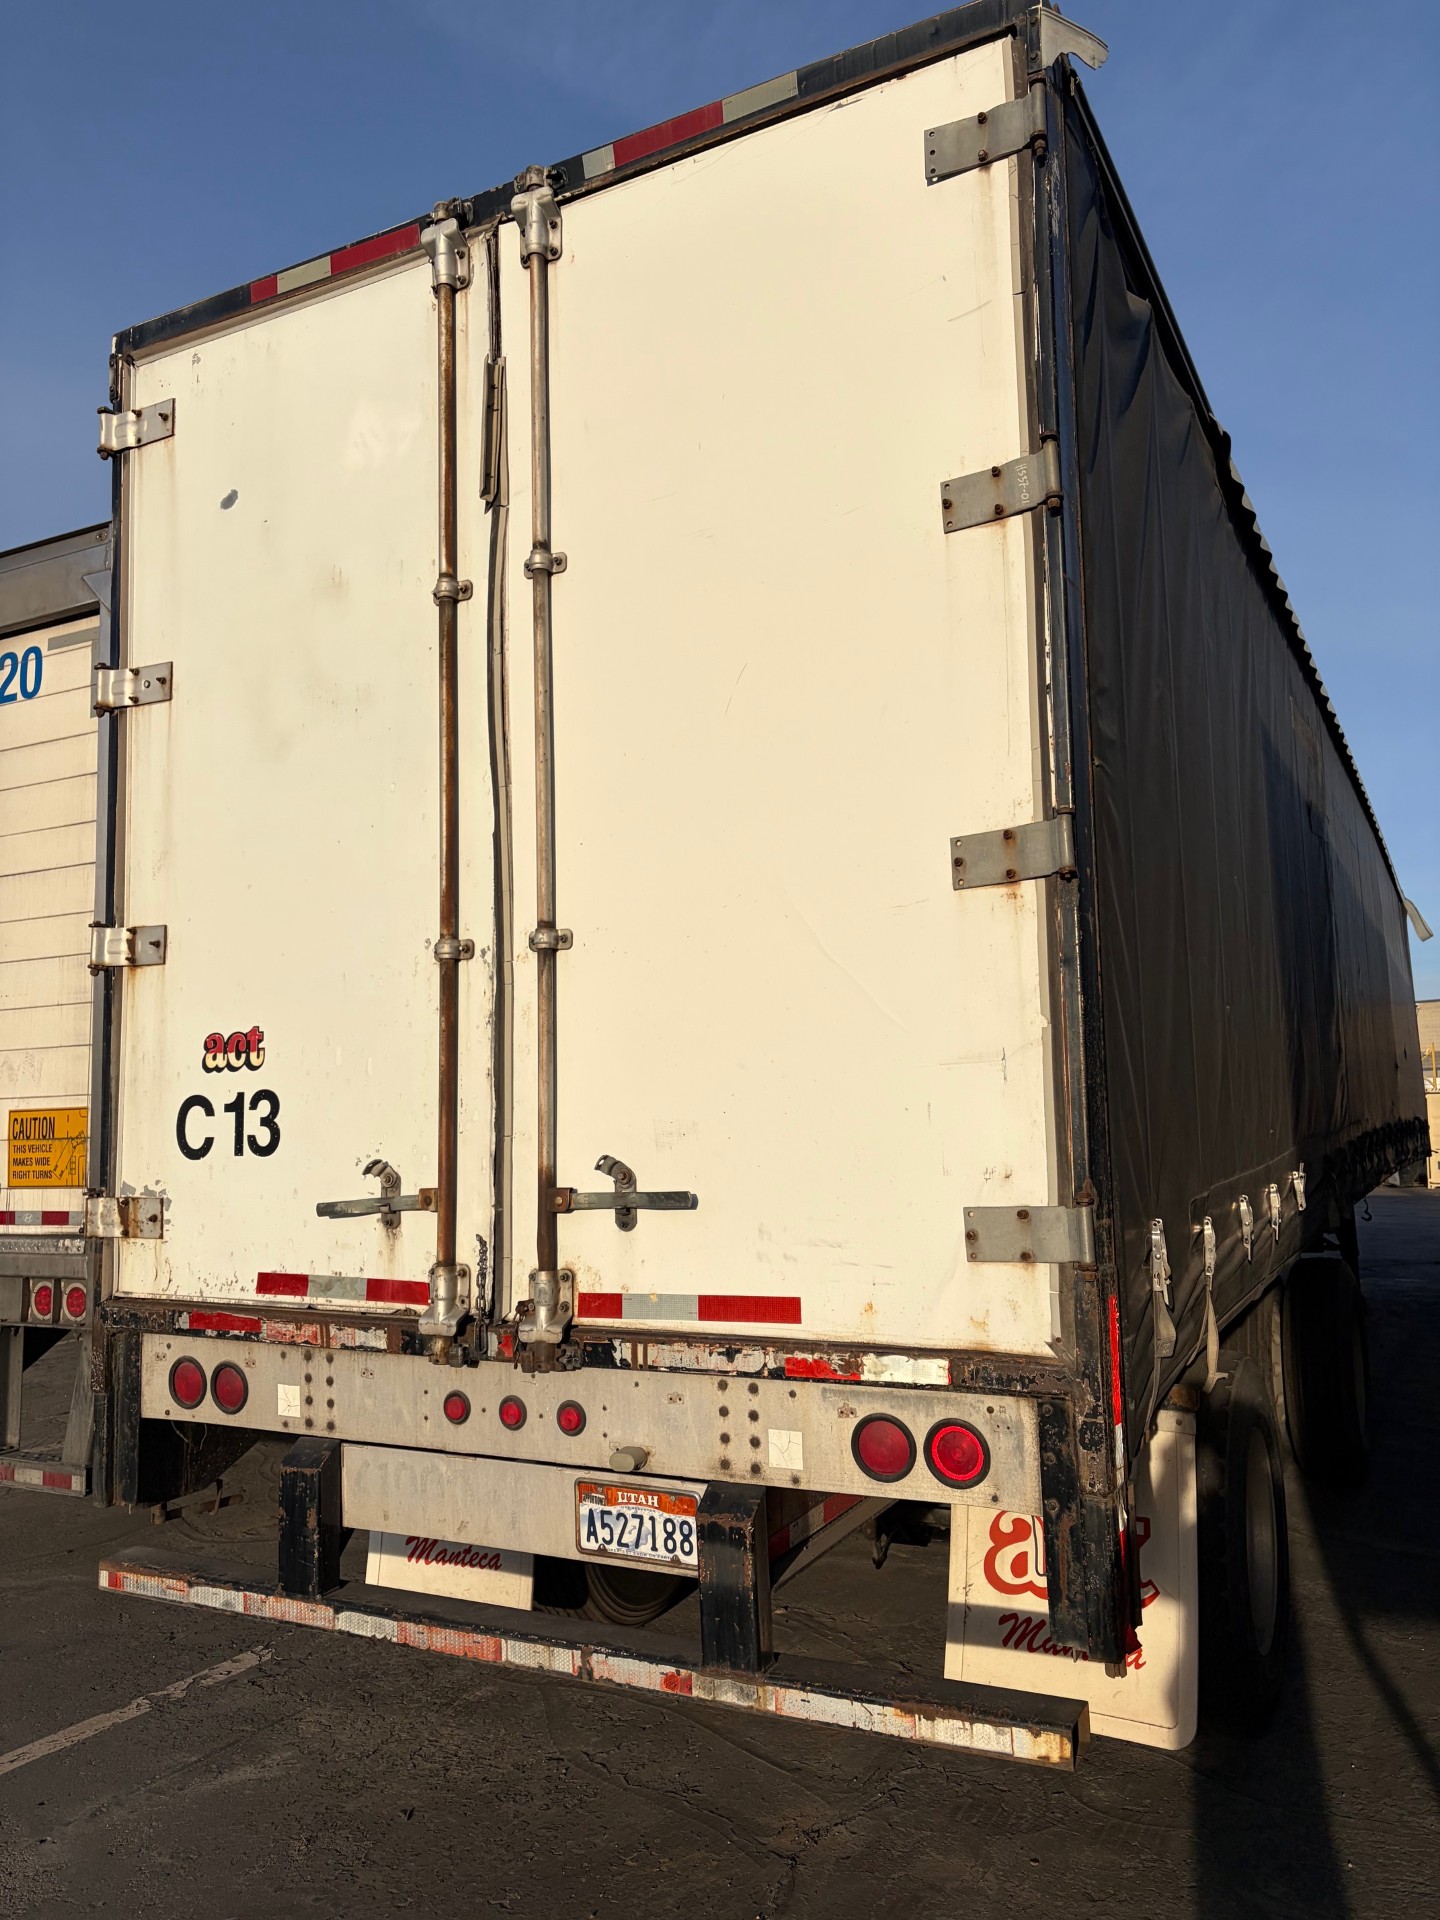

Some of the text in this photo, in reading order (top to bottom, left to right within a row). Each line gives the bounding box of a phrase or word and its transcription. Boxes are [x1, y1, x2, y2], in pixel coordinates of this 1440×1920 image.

[0, 645, 43, 705] 20
[202, 1026, 265, 1073] act
[12, 1116, 55, 1140] CAUTION
[13, 1144, 53, 1154] THIS VEHICLE
[12, 1157, 50, 1167] MAKES WIDE
[12, 1170, 53, 1180] RIGHT TURNS
[616, 1491, 660, 1507] UTAH
[586, 1508, 694, 1557] A527188
[405, 1536, 502, 1571] Manteca
